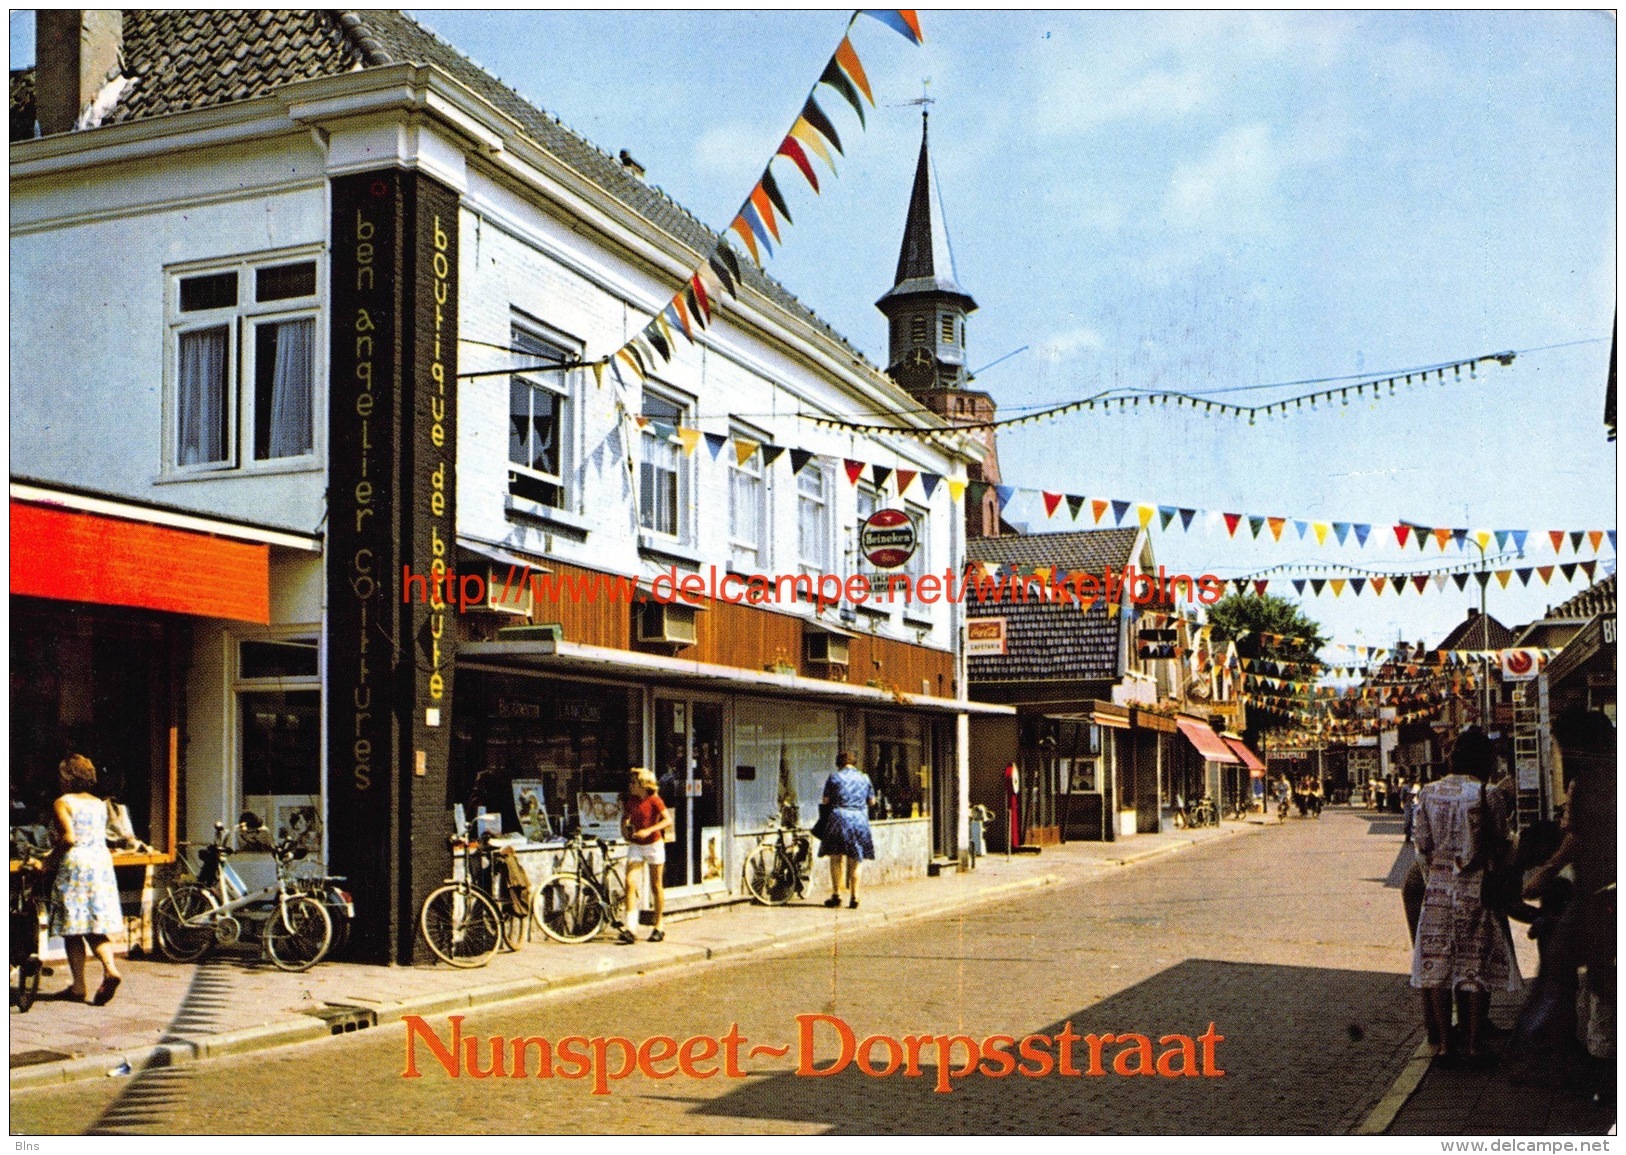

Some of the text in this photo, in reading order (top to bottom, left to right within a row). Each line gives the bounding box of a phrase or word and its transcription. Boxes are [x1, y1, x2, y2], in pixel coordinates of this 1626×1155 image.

[355, 208, 375, 291] ben
[431, 214, 449, 447] boutique
[431, 461, 446, 517] de
[865, 532, 911, 545] Heineken
